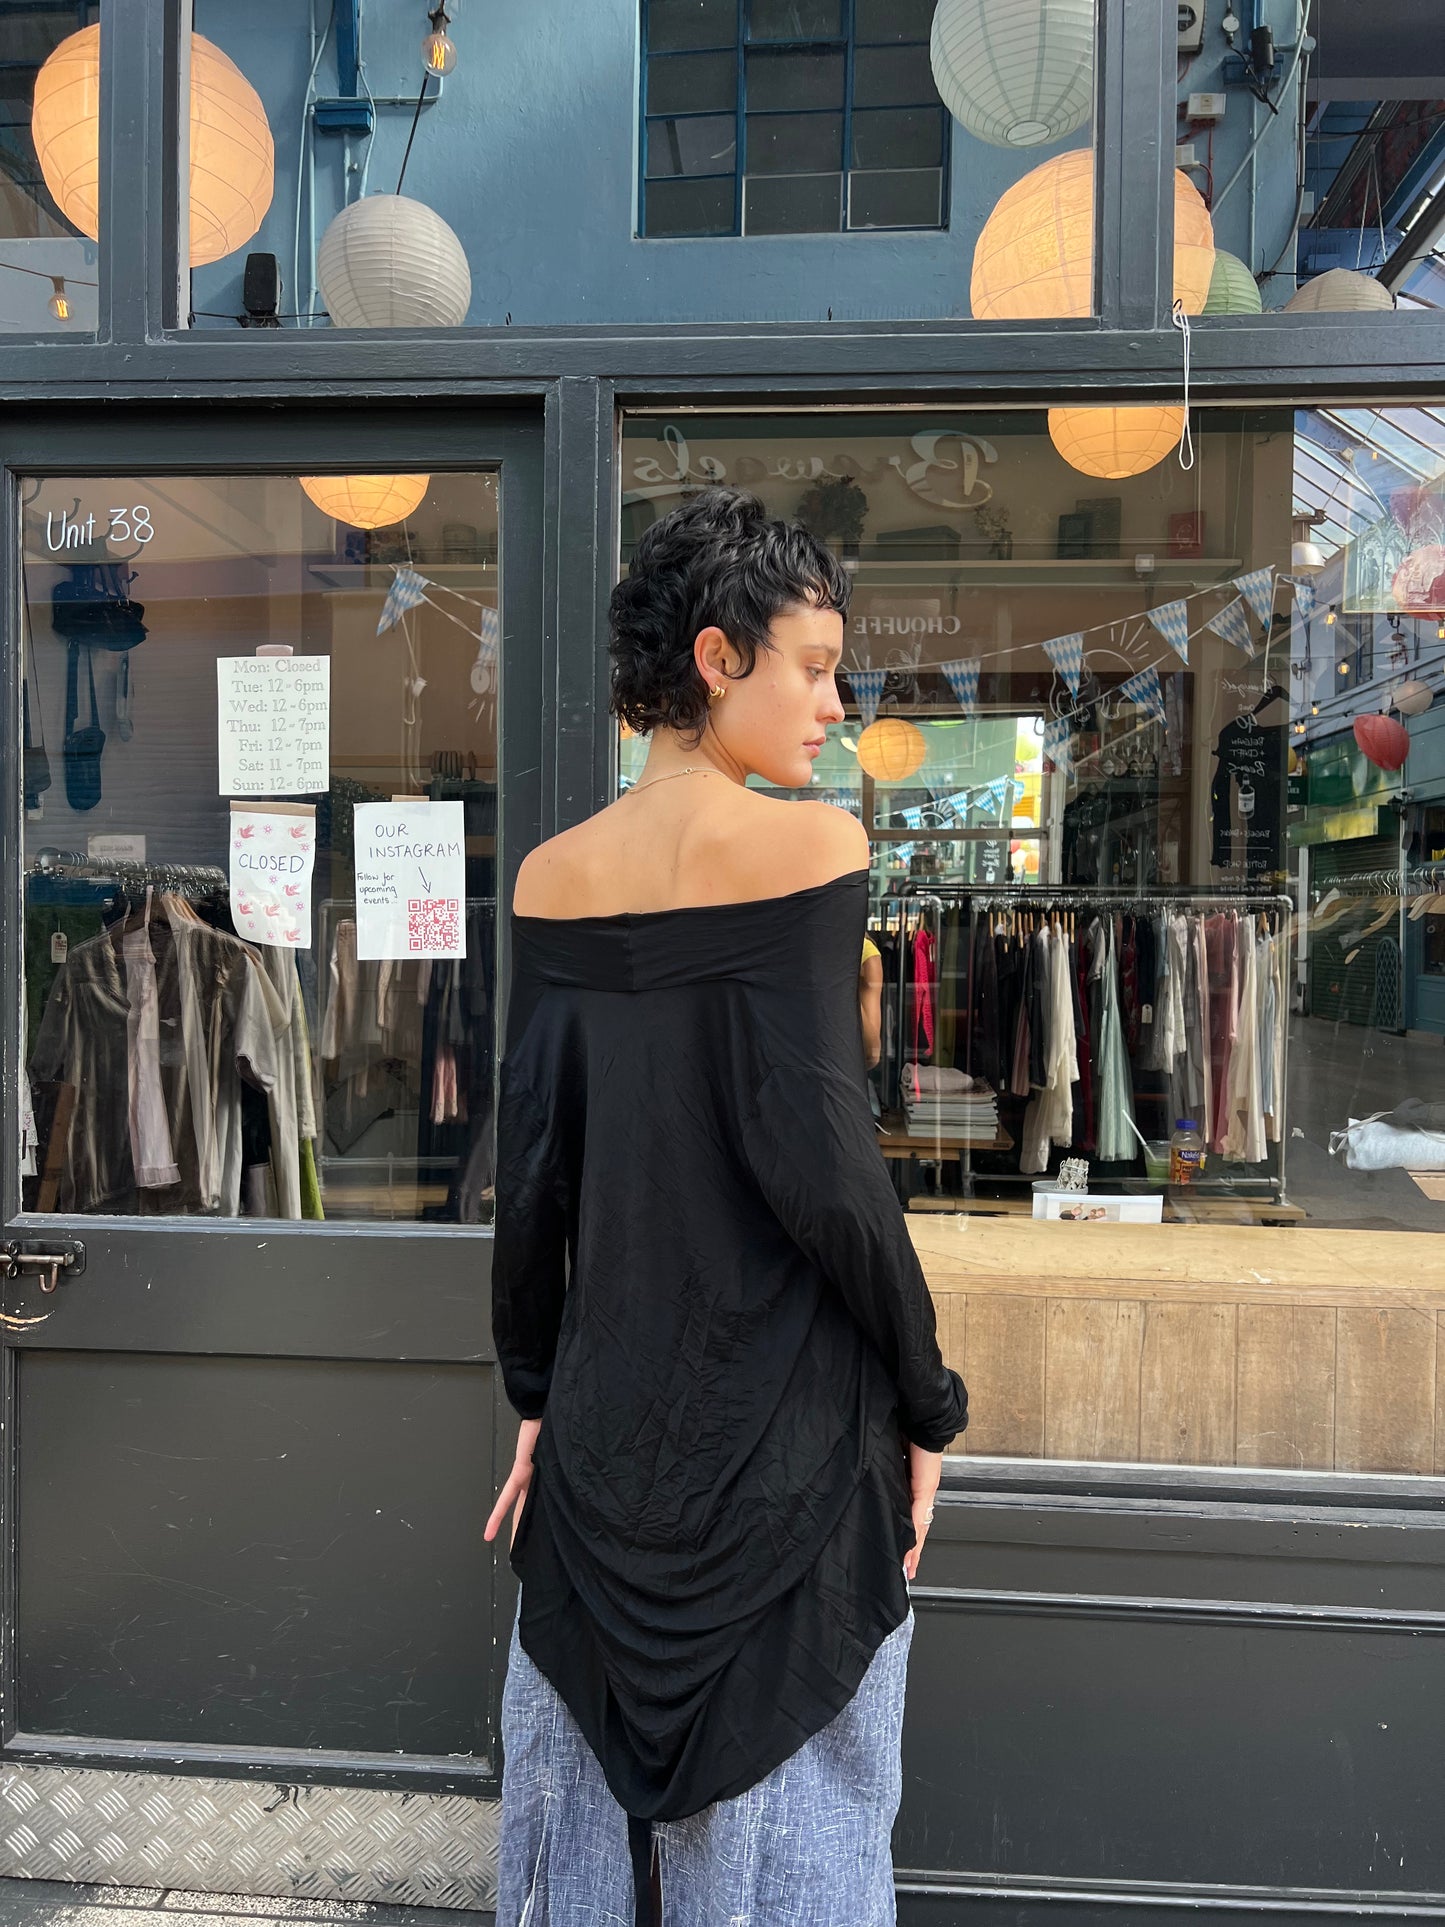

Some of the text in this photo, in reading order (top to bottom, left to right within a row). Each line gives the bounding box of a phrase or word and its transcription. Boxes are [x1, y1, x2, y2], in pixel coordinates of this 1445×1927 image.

[46, 505, 155, 552] Unit 38
[233, 659, 321, 673] Mon: Closed
[231, 680, 263, 693] Tue:
[268, 678, 284, 693] 12
[294, 678, 324, 695] 6pm
[229, 699, 267, 713] Wed:
[272, 698, 288, 712] 12
[298, 698, 328, 715] 6pm
[226, 719, 261, 733] Thu:
[271, 717, 287, 732] 12
[299, 718, 326, 735] 7pm
[238, 739, 263, 752] Fri:
[267, 737, 283, 752] 12
[295, 738, 323, 754] 7pm
[238, 758, 264, 771] Sat:
[269, 758, 282, 771] 11
[296, 758, 323, 773] 7pm
[232, 777, 264, 791] Sun:
[270, 777, 286, 791] 12
[297, 777, 325, 793] 6pm
[375, 823, 409, 838] OUR
[369, 842, 461, 858] INSTAGRAM
[238, 853, 305, 873] CLOSED
[357, 872, 395, 886] Follow for
[359, 885, 398, 898] upcoming
